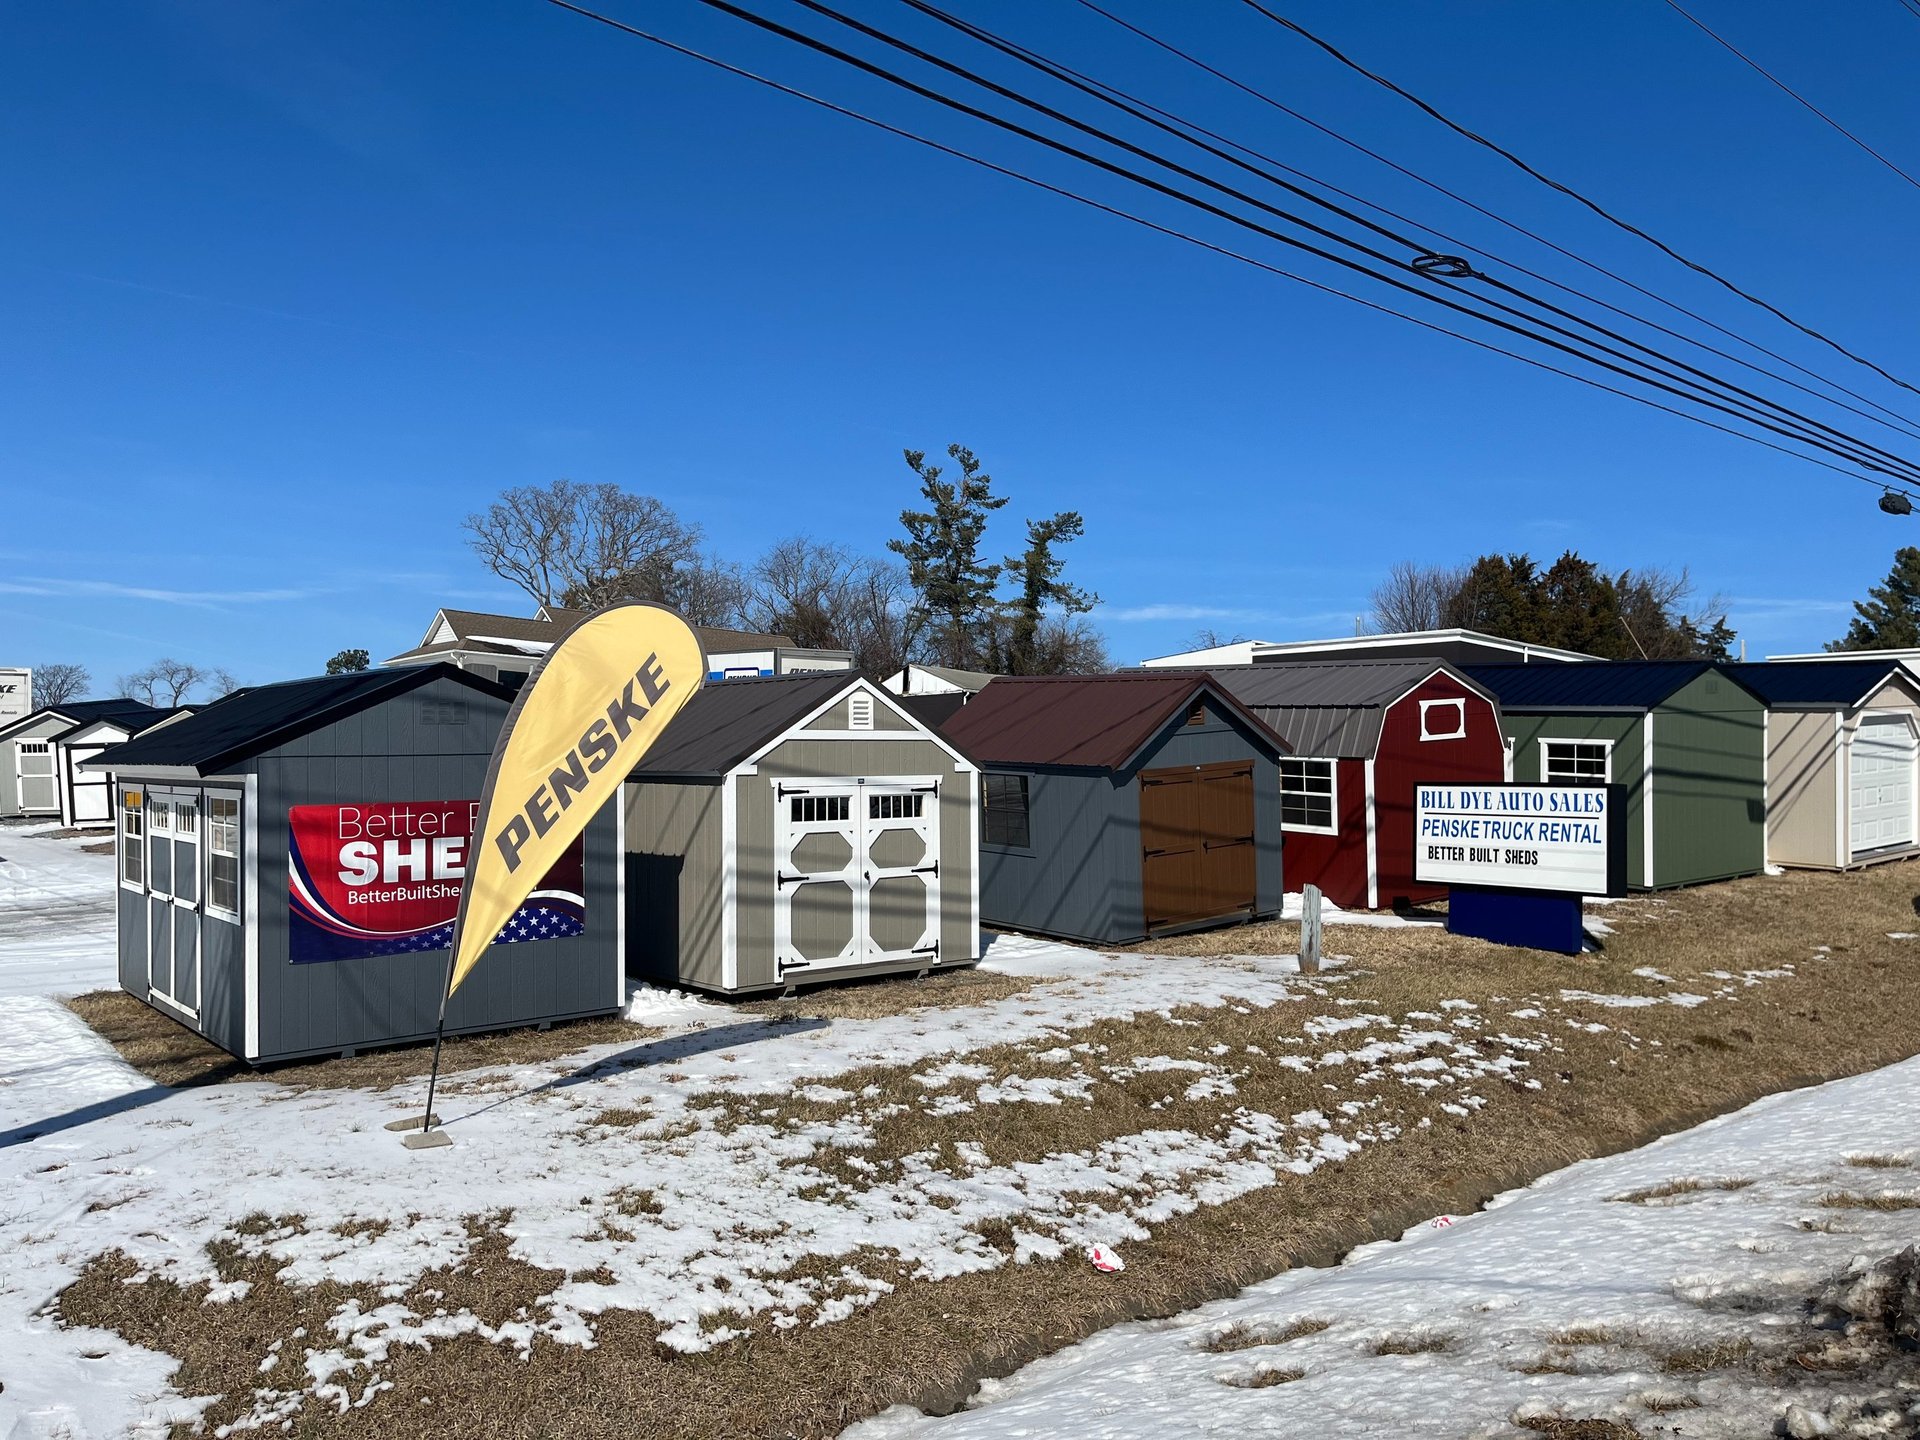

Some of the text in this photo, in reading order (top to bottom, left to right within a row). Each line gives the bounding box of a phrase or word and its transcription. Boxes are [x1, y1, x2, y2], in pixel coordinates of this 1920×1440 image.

[495, 651, 671, 874] PENSKE
[1420, 790, 1604, 813] BILL DYE AUTO SALES
[339, 806, 455, 840] Better
[1422, 818, 1602, 844] PENSKE TRUCK RENTAL
[338, 836, 473, 886] SHE
[1428, 845, 1538, 865] BETTER BUILT SHEDS
[348, 884, 463, 905] BetterBuiltShe
